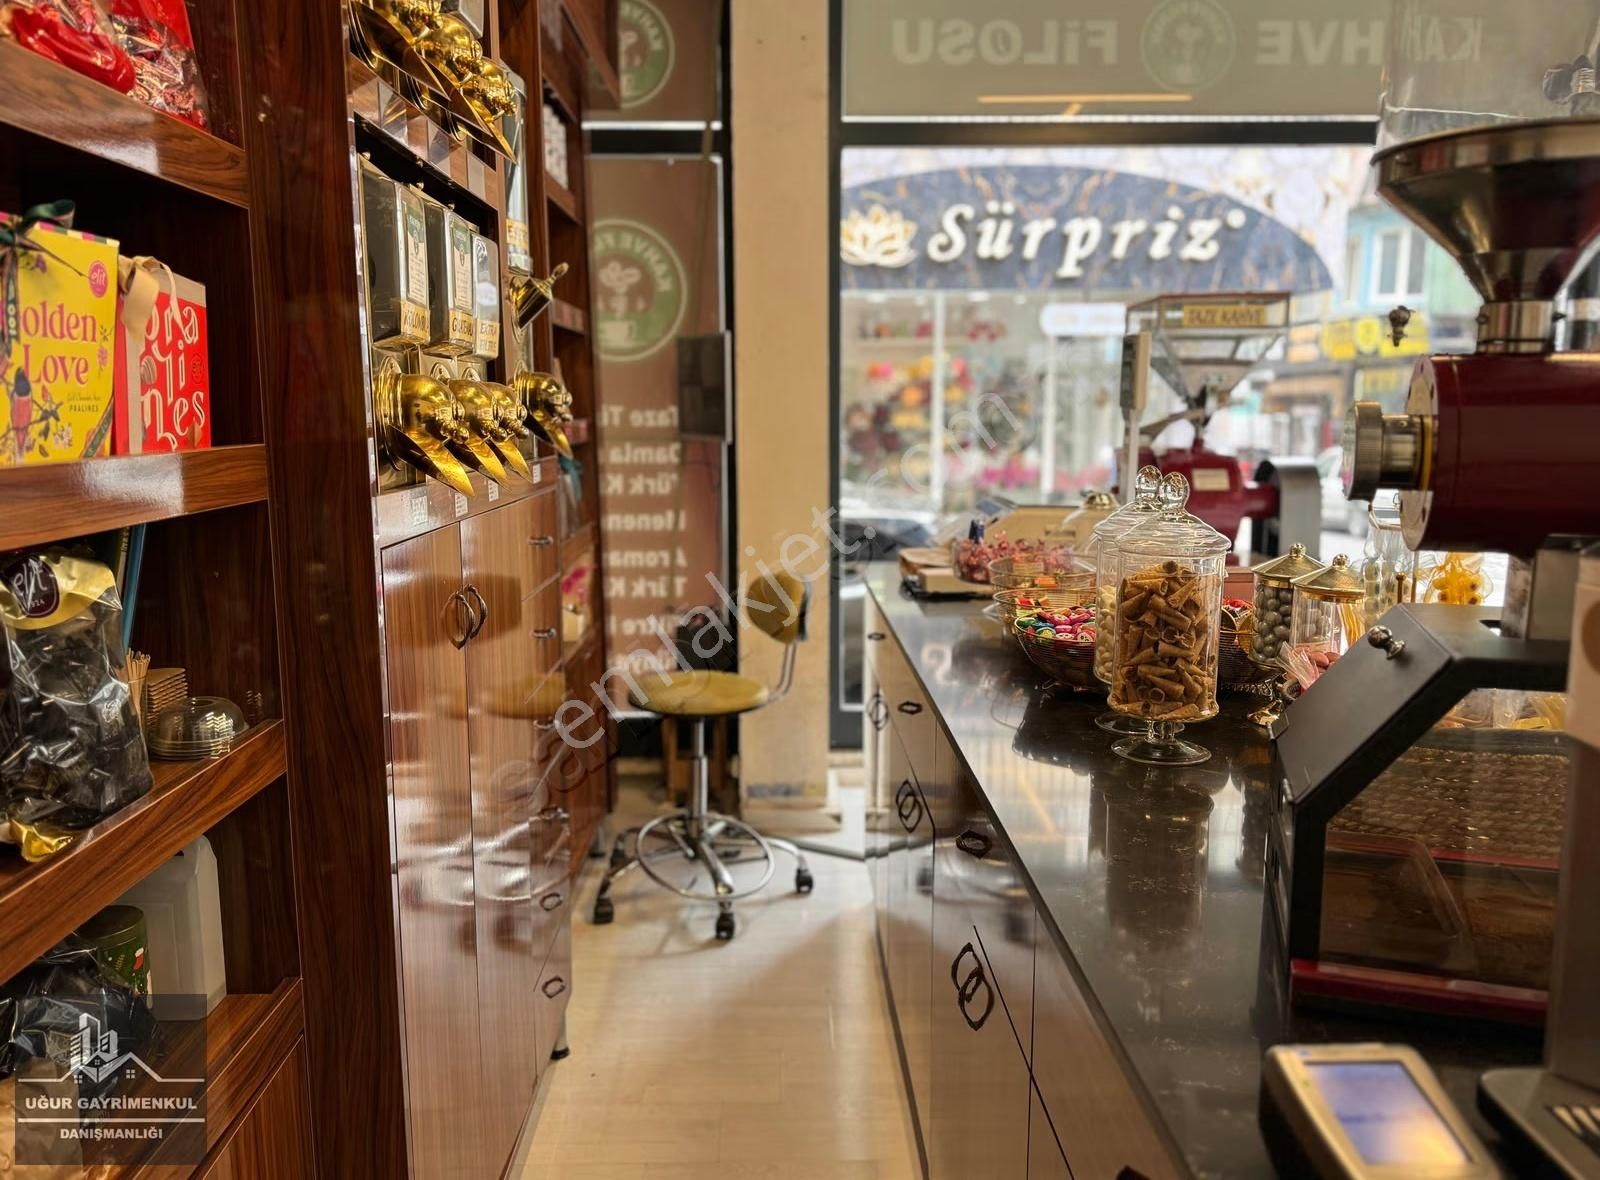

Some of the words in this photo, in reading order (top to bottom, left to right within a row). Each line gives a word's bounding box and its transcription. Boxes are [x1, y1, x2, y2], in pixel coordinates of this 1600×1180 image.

[927, 203, 1221, 278] Sürpriz
[21, 300, 97, 343] olden
[23, 343, 90, 389] Love
